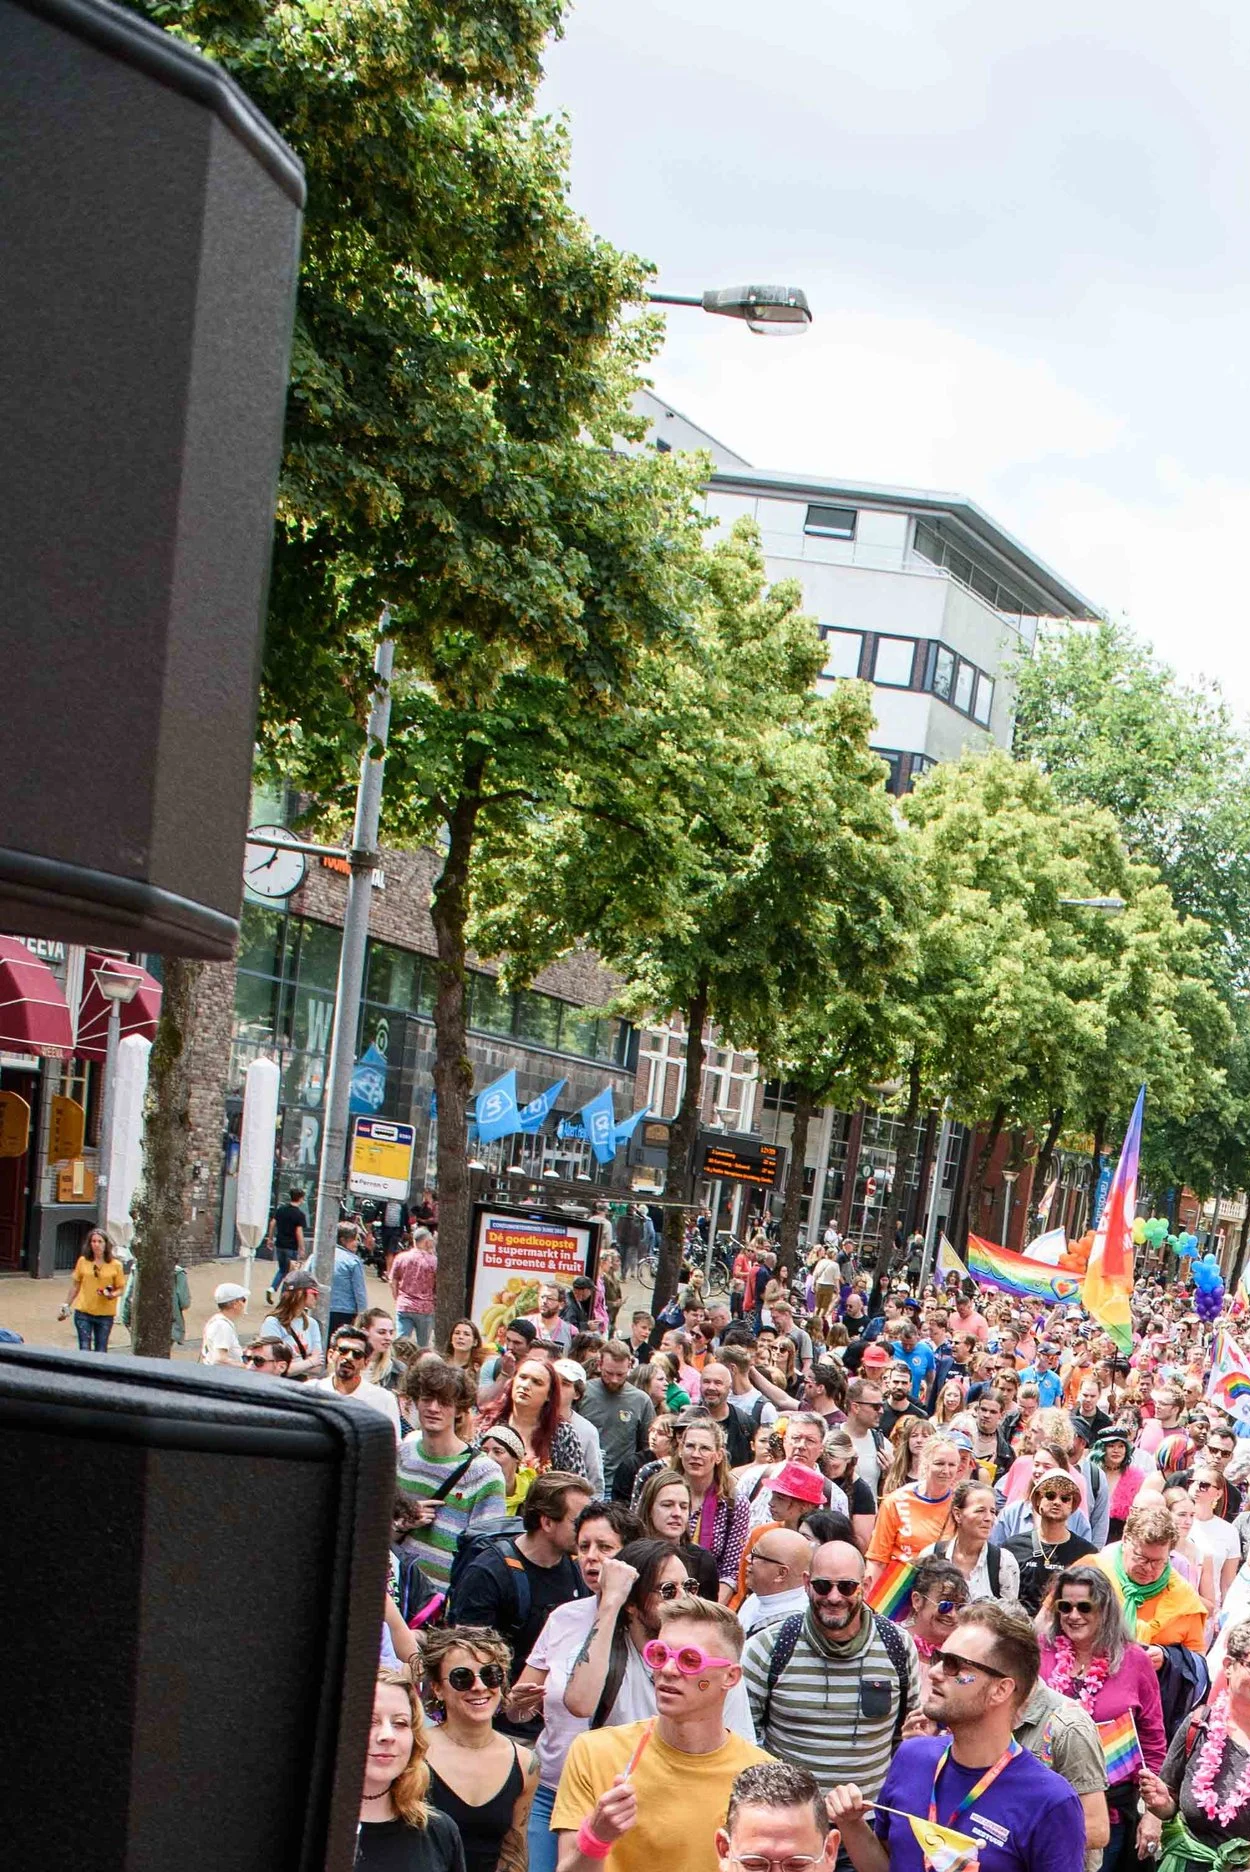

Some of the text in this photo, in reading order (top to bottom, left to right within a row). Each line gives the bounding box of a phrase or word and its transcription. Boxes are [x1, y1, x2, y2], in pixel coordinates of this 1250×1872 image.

[488, 1232, 575, 1249] Dé goedkoopste
[498, 1246, 571, 1260] supermarkt in
[485, 1254, 582, 1272] bio groente & fruit
